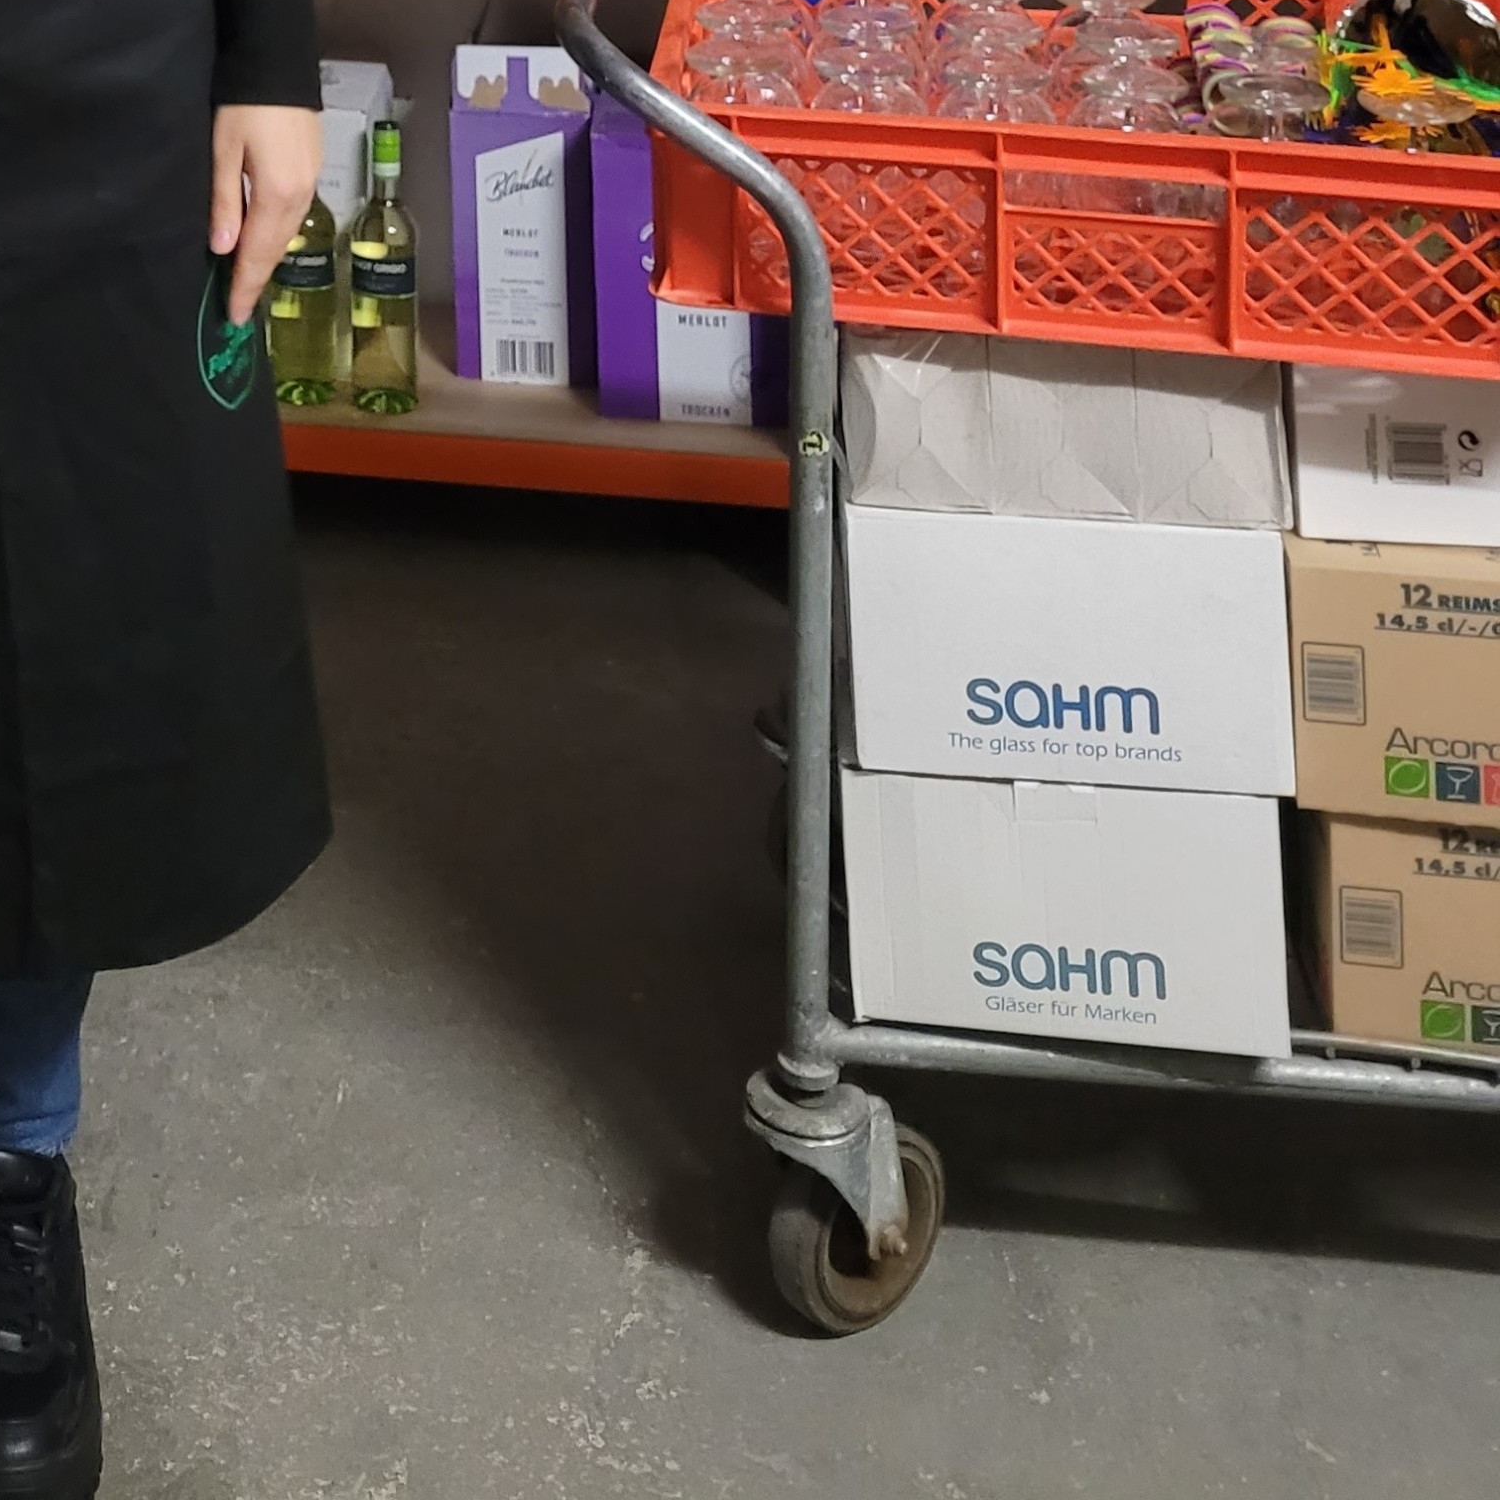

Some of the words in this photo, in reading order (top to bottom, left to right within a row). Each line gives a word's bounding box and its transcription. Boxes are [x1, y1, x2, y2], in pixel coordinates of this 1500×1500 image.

[502, 228, 539, 239] MERLOT
[677, 314, 729, 330] MERLOT
[681, 403, 731, 418] TROCKEN
[1400, 583, 1432, 608] 12
[1376, 613, 1429, 631] 14,5
[948, 732, 984, 750] The
[989, 735, 1036, 755] glass
[1042, 738, 1070, 755] for
[1076, 742, 1108, 762] top
[1115, 743, 1183, 763] brands
[1438, 828, 1470, 851] 12
[1413, 857, 1466, 874] 14,5
[985, 995, 1045, 1015] Gläser
[1051, 1000, 1079, 1017] für
[1084, 1004, 1158, 1024] Marken
